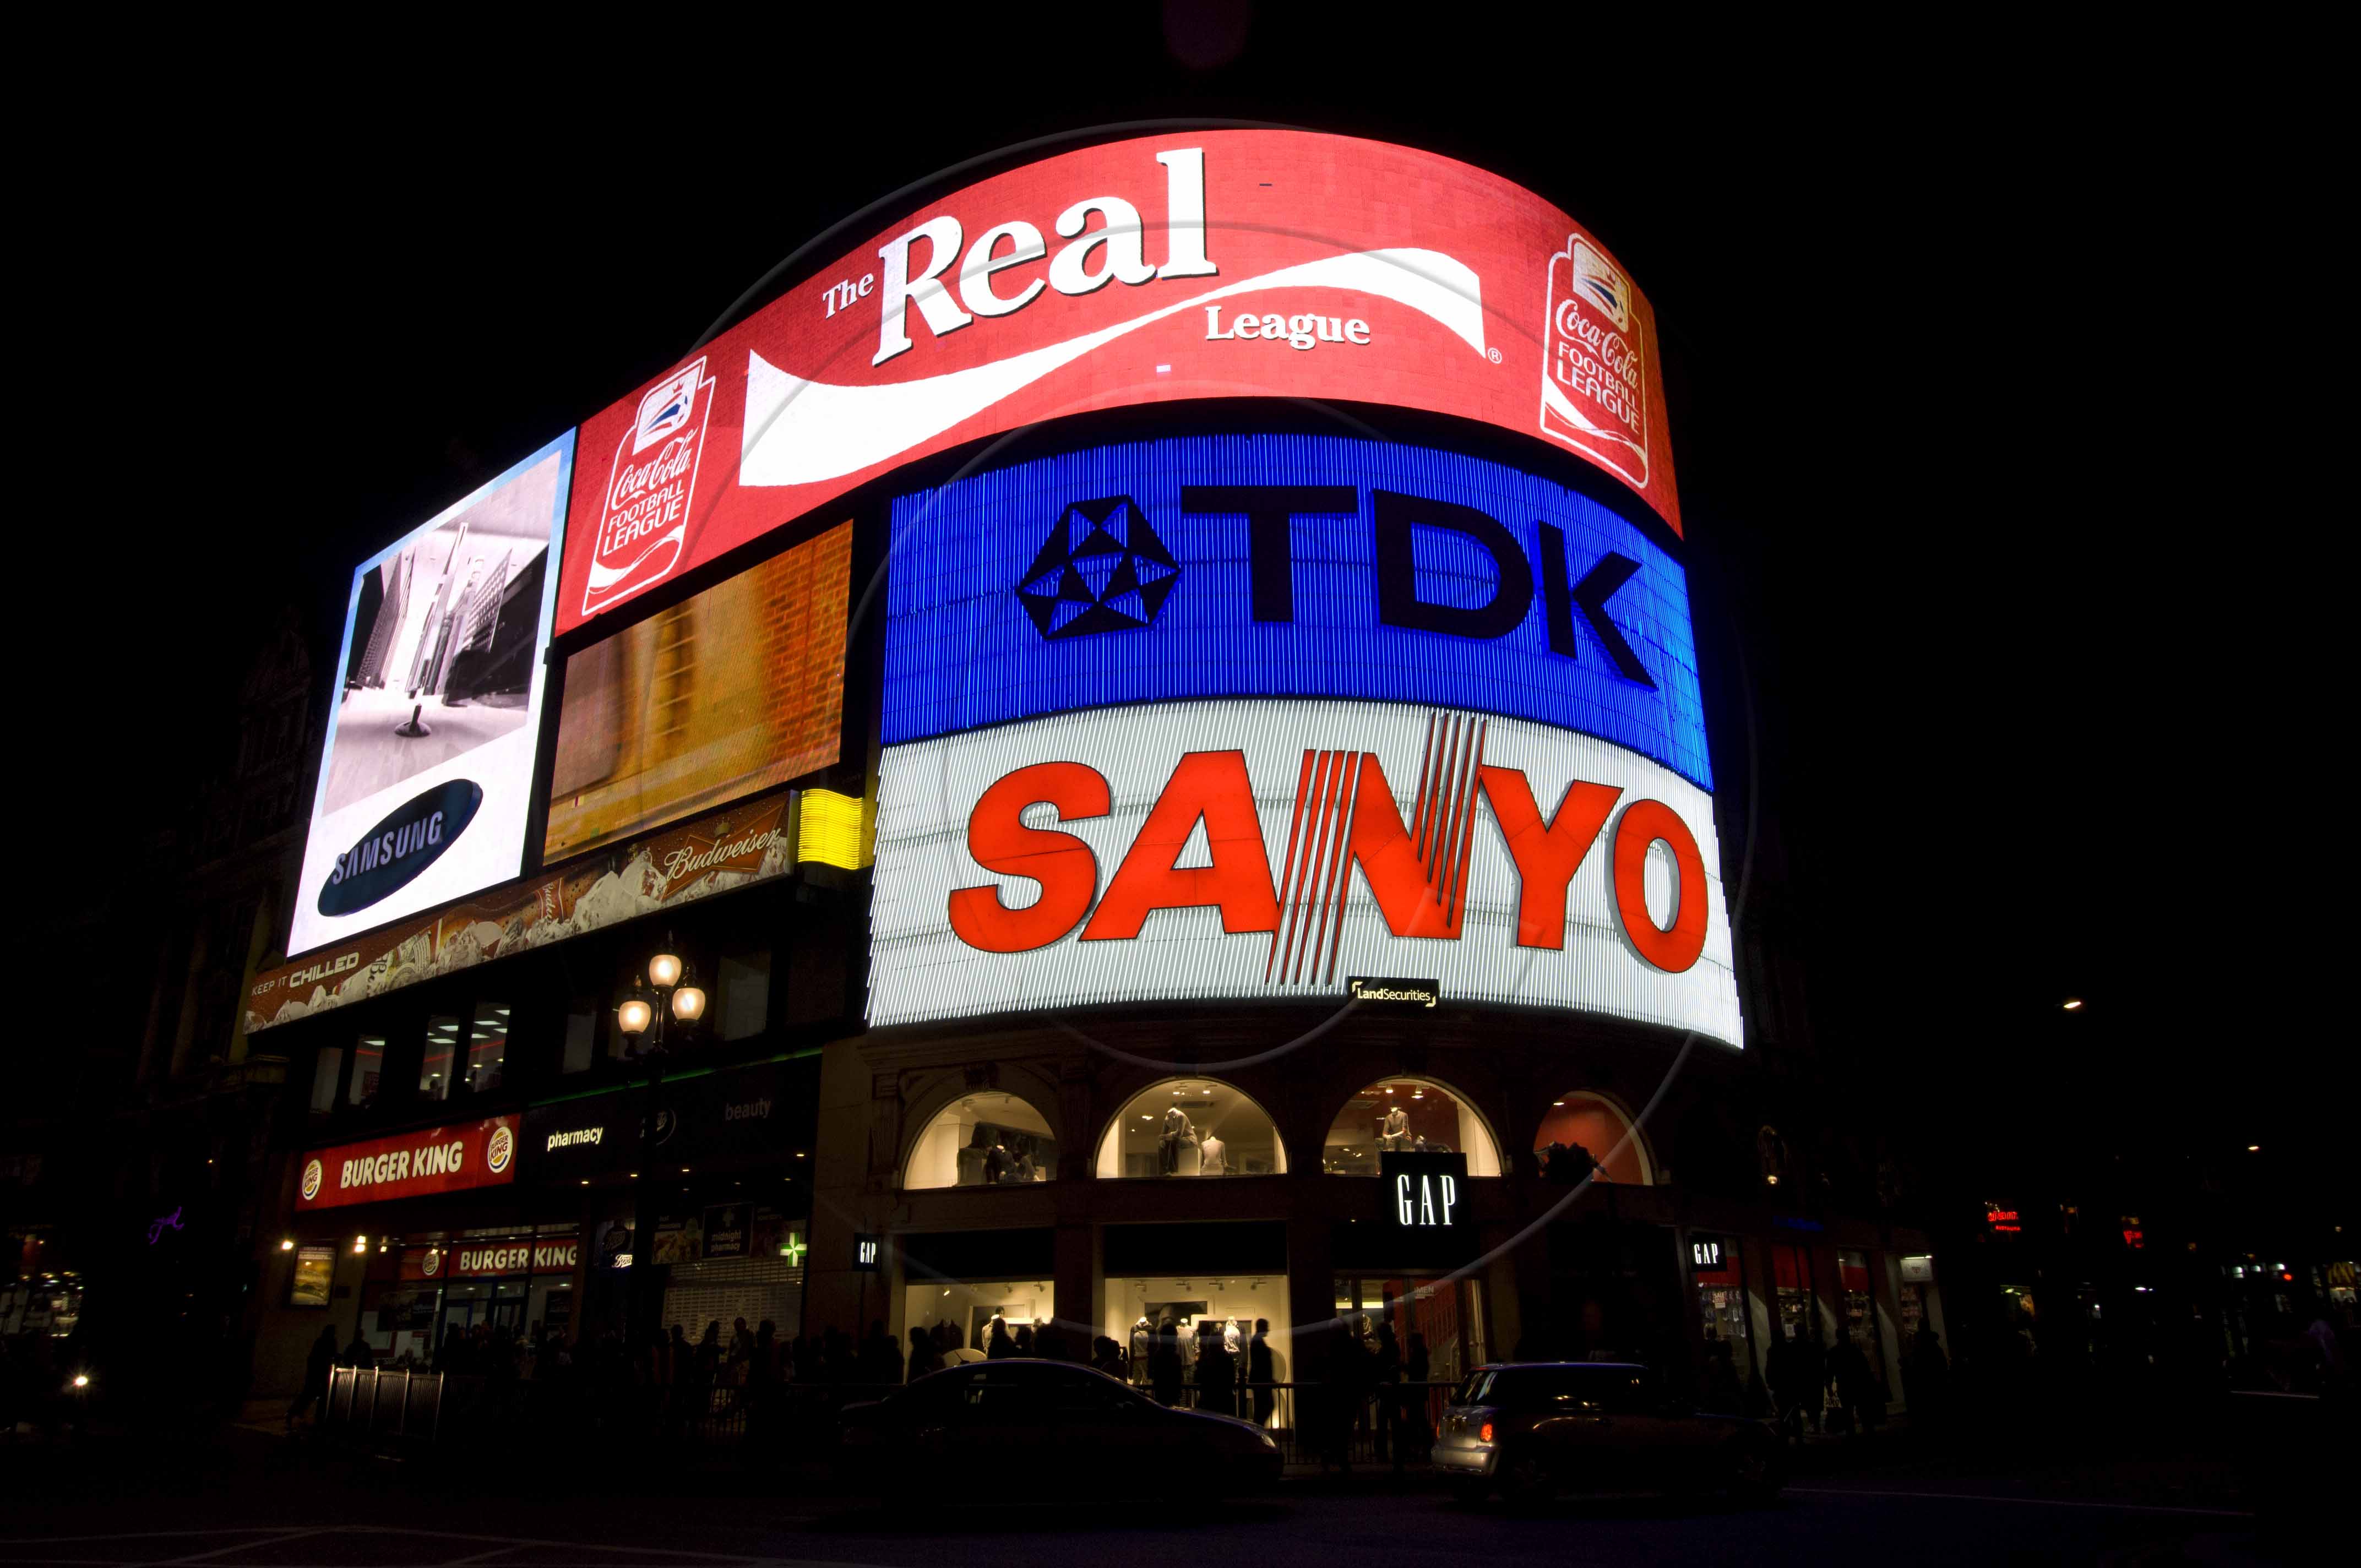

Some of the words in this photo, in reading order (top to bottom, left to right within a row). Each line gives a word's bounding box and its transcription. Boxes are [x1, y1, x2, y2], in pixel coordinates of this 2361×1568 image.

[822, 272, 874, 320] The
[872, 148, 1219, 367] Real
[1205, 306, 1371, 350] League
[1556, 299, 1639, 388] Coca-Cola
[1557, 359, 1640, 434] LEAGUE
[1558, 341, 1636, 409] FOOTBALL
[612, 426, 699, 510] Coca-Cola
[602, 497, 683, 557] LEAGUE
[608, 480, 684, 534] FOOTBALL
[1182, 485, 1657, 690] TDK
[333, 811, 443, 885] SAMSUNG
[664, 828, 781, 881] Budweiser
[949, 712, 1708, 984] SANYO
[252, 980, 275, 996] KEEP
[278, 975, 287, 987] IT
[290, 952, 360, 988] CHILLED
[724, 1097, 773, 1121] beauty
[340, 1151, 410, 1189] BURGER
[412, 1141, 463, 1178] KING
[490, 1142, 508, 1161] KING
[547, 1127, 603, 1152] pharmacy
[1396, 1174, 1456, 1226] GAP
[460, 1248, 529, 1271] BURGER
[534, 1245, 577, 1267] KING
[860, 1242, 876, 1264] GAP
[1694, 1243, 1718, 1264] GAP
